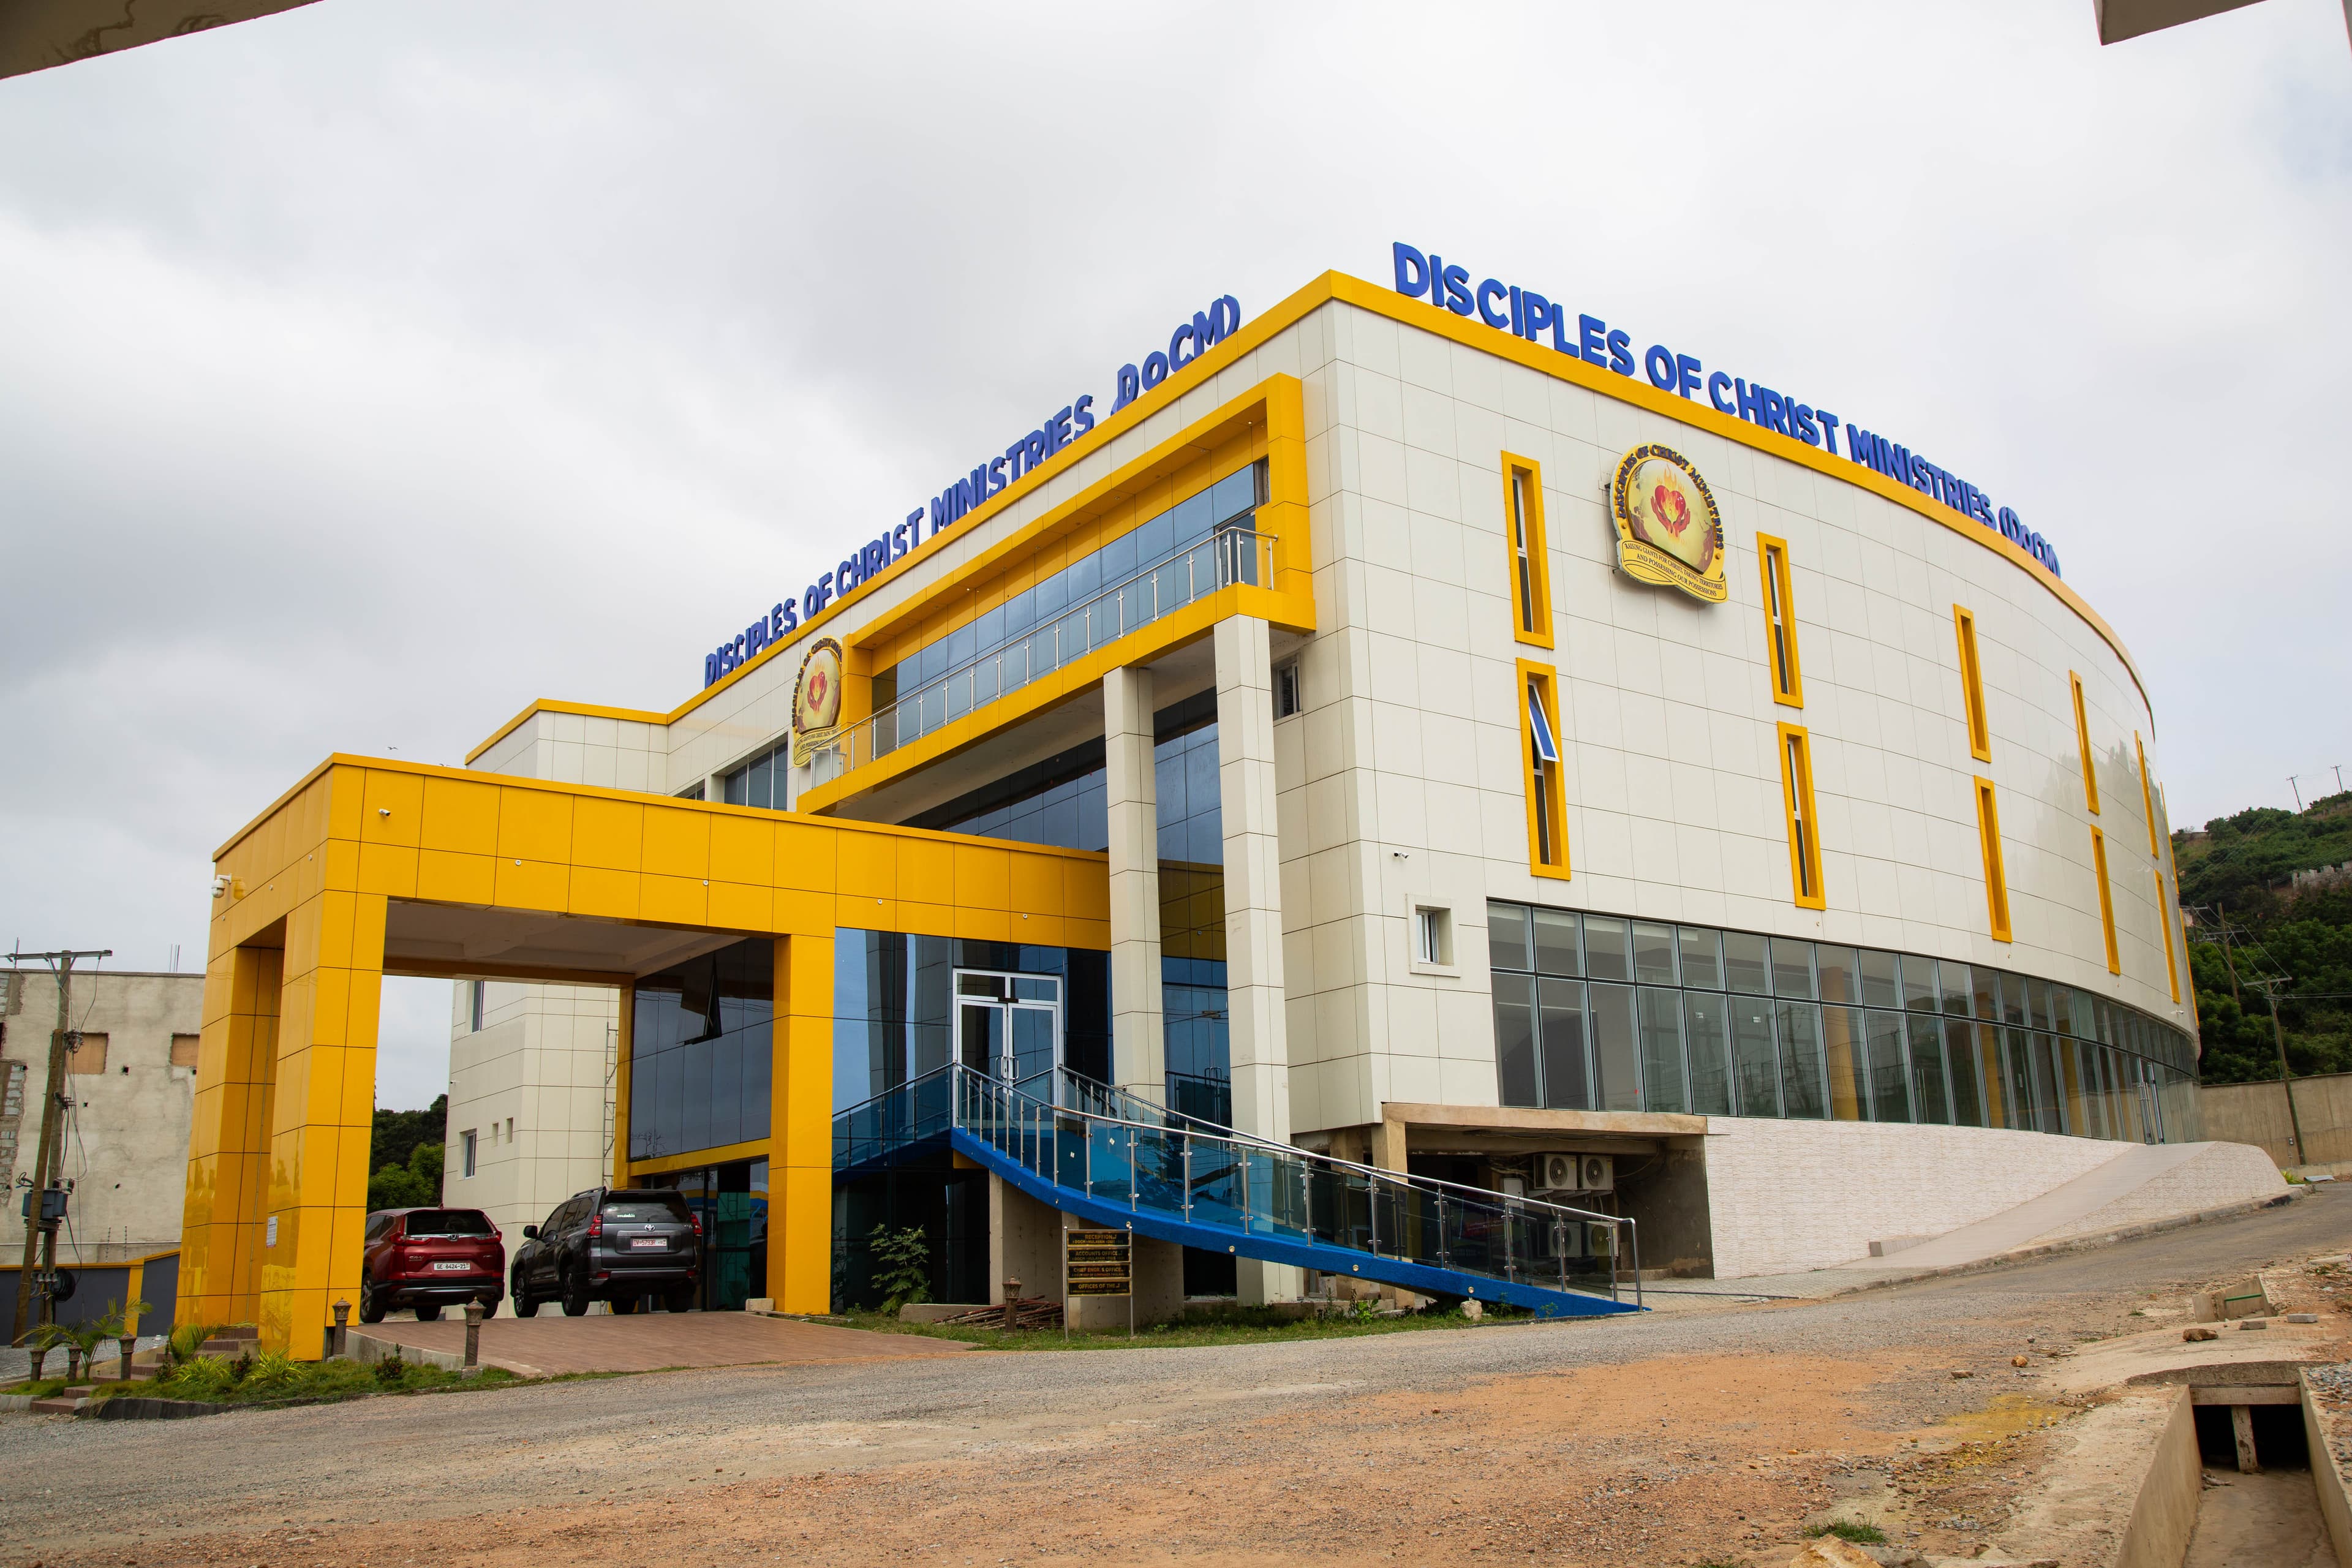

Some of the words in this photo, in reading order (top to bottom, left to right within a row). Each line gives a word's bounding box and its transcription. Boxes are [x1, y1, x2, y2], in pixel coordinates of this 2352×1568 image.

[1393, 241, 1635, 377] DISCIPLES
[1645, 344, 1702, 399] OF
[1708, 371, 1839, 456] CHRIST
[1847, 423, 1997, 531] MINISTRIES
[704, 598, 797, 688] DISCIPLES
[803, 571, 833, 621] OF
[835, 507, 925, 598] CHRIST
[930, 394, 1095, 536] MINISTRIES
[1616, 453, 1638, 519] DISCIPLES
[1636, 445, 1649, 459] OF
[1650, 444, 1690, 471] CHRIST
[1689, 467, 1725, 550] MINISTRIES
[1637, 553, 1648, 562] AND
[1649, 558, 1677, 578] POSSESSING
[1677, 574, 1688, 584] OUR
[1688, 581, 1717, 597] POSSESSIONS
[1658, 555, 1668, 564] FOR
